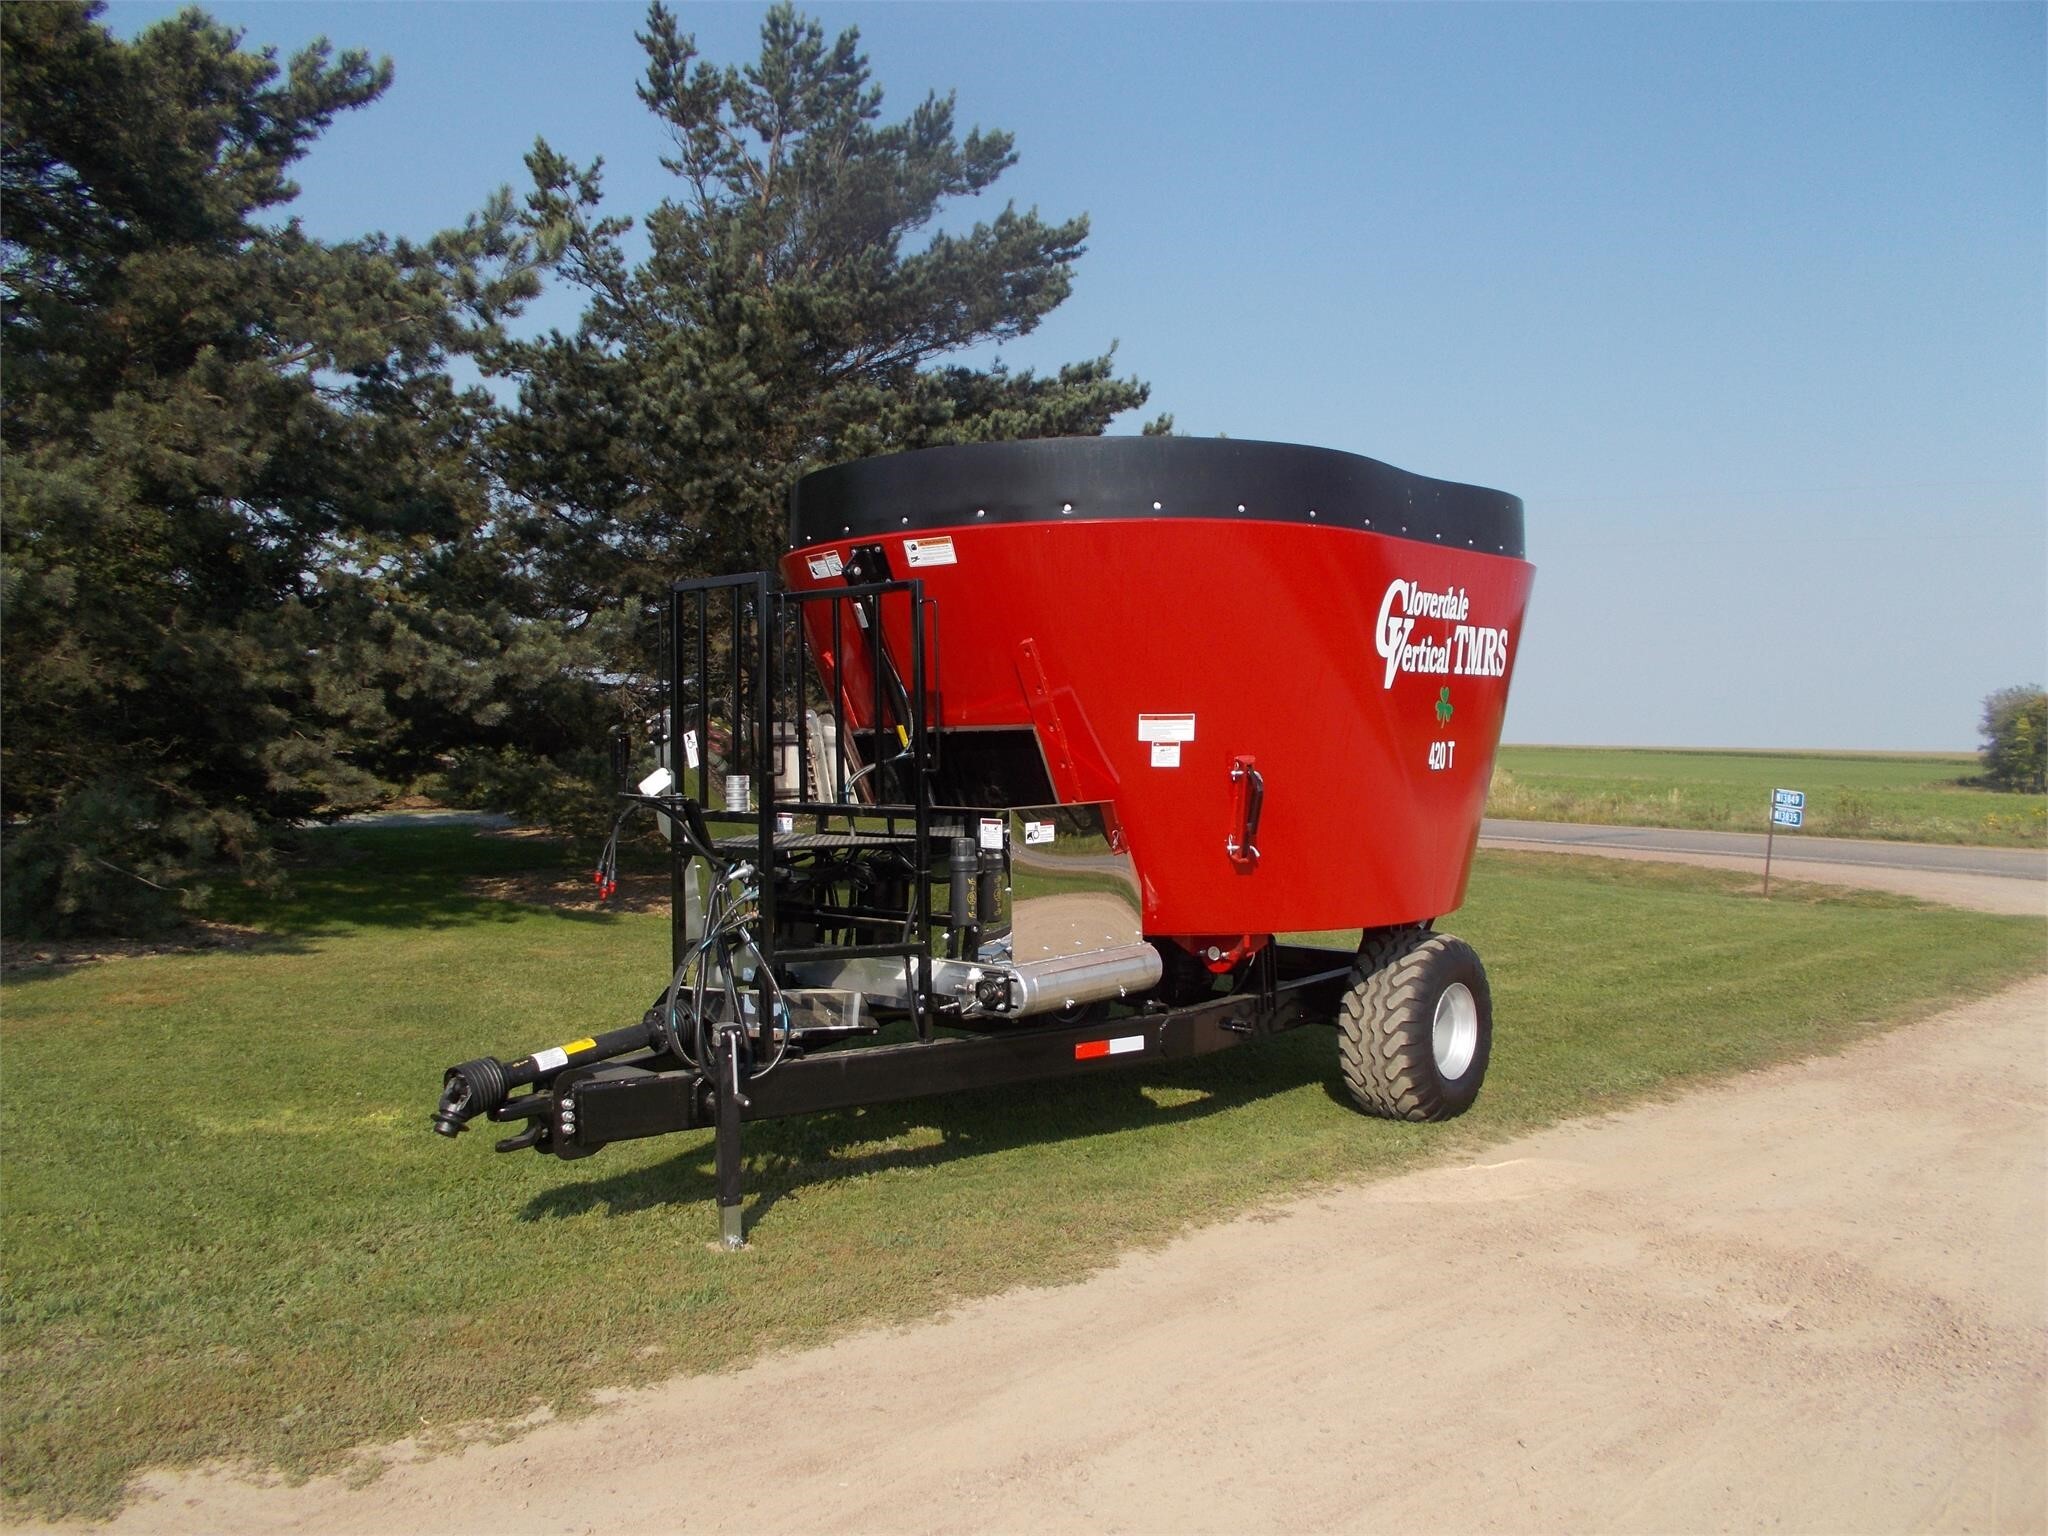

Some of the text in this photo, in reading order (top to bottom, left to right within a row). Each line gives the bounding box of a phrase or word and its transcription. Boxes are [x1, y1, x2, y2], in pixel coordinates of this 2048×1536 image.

[1375, 578, 1469, 658] Cloverdale
[1384, 617, 1508, 689] Vertical TMRS
[1428, 741, 1455, 770] 420 T
